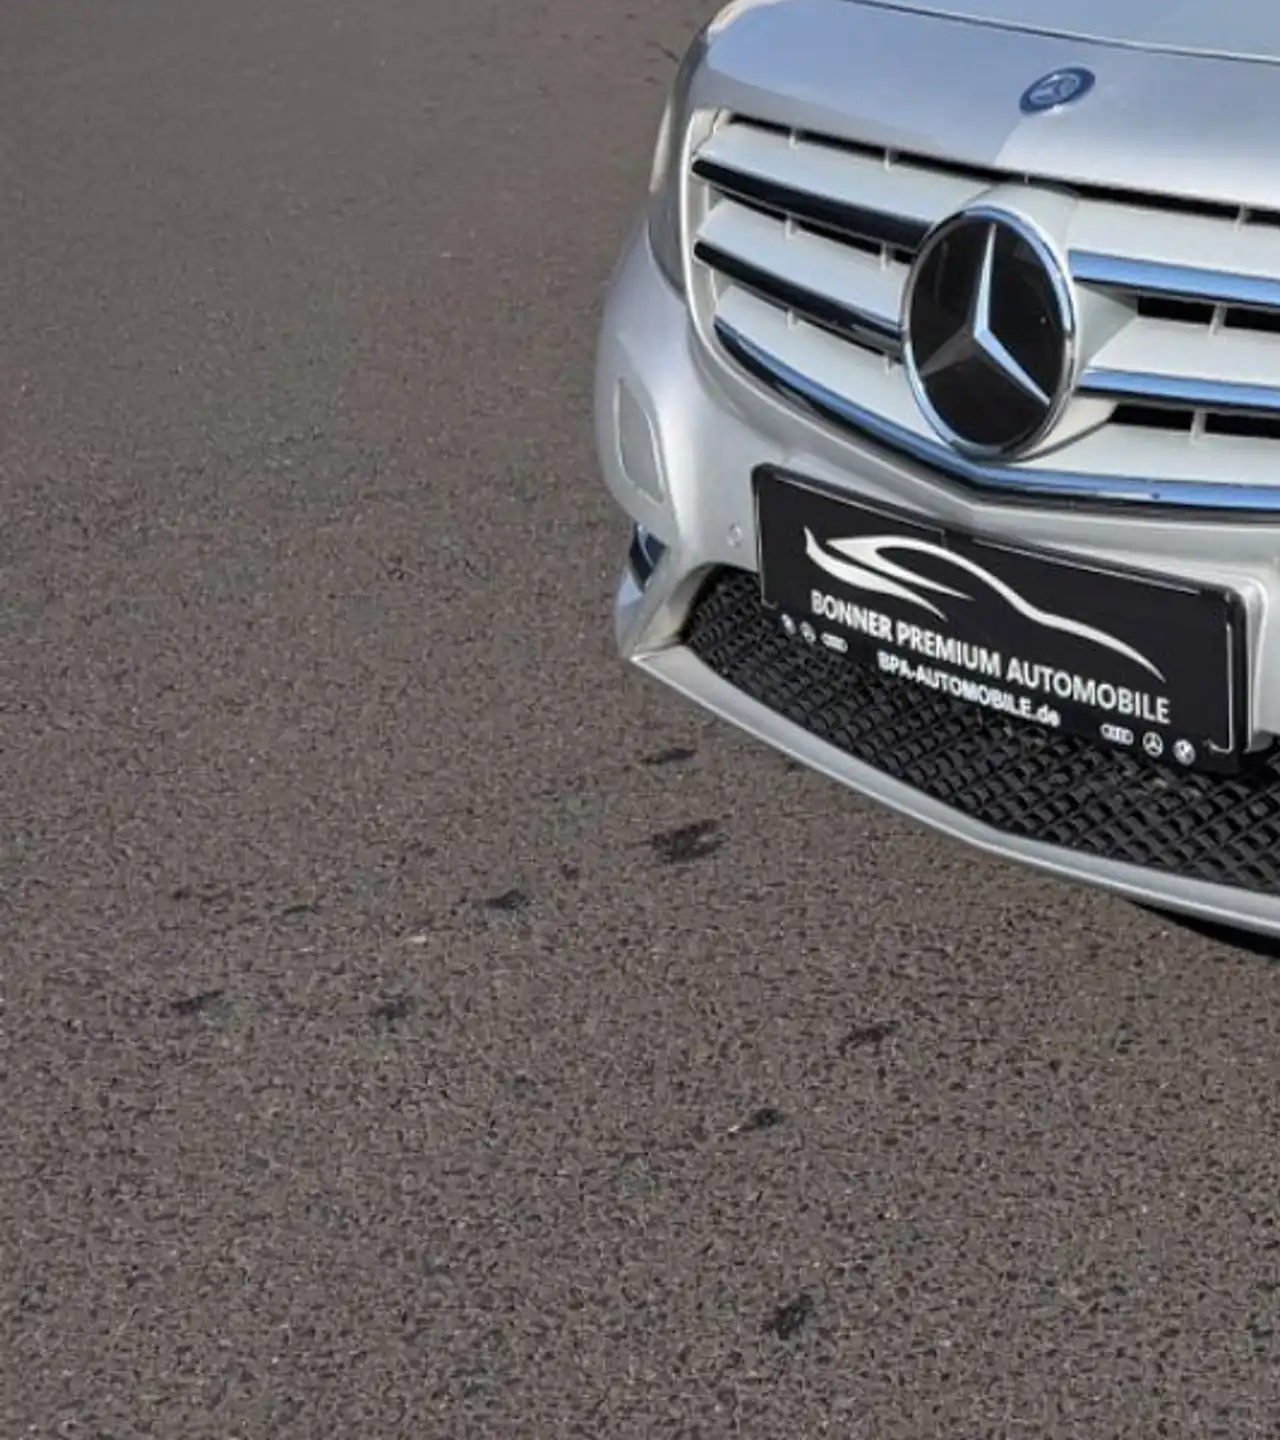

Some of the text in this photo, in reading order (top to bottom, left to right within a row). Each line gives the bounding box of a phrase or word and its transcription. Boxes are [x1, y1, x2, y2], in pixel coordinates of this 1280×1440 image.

[810, 588, 1172, 725] BONNER PREMIUM AUTOMOBILE
